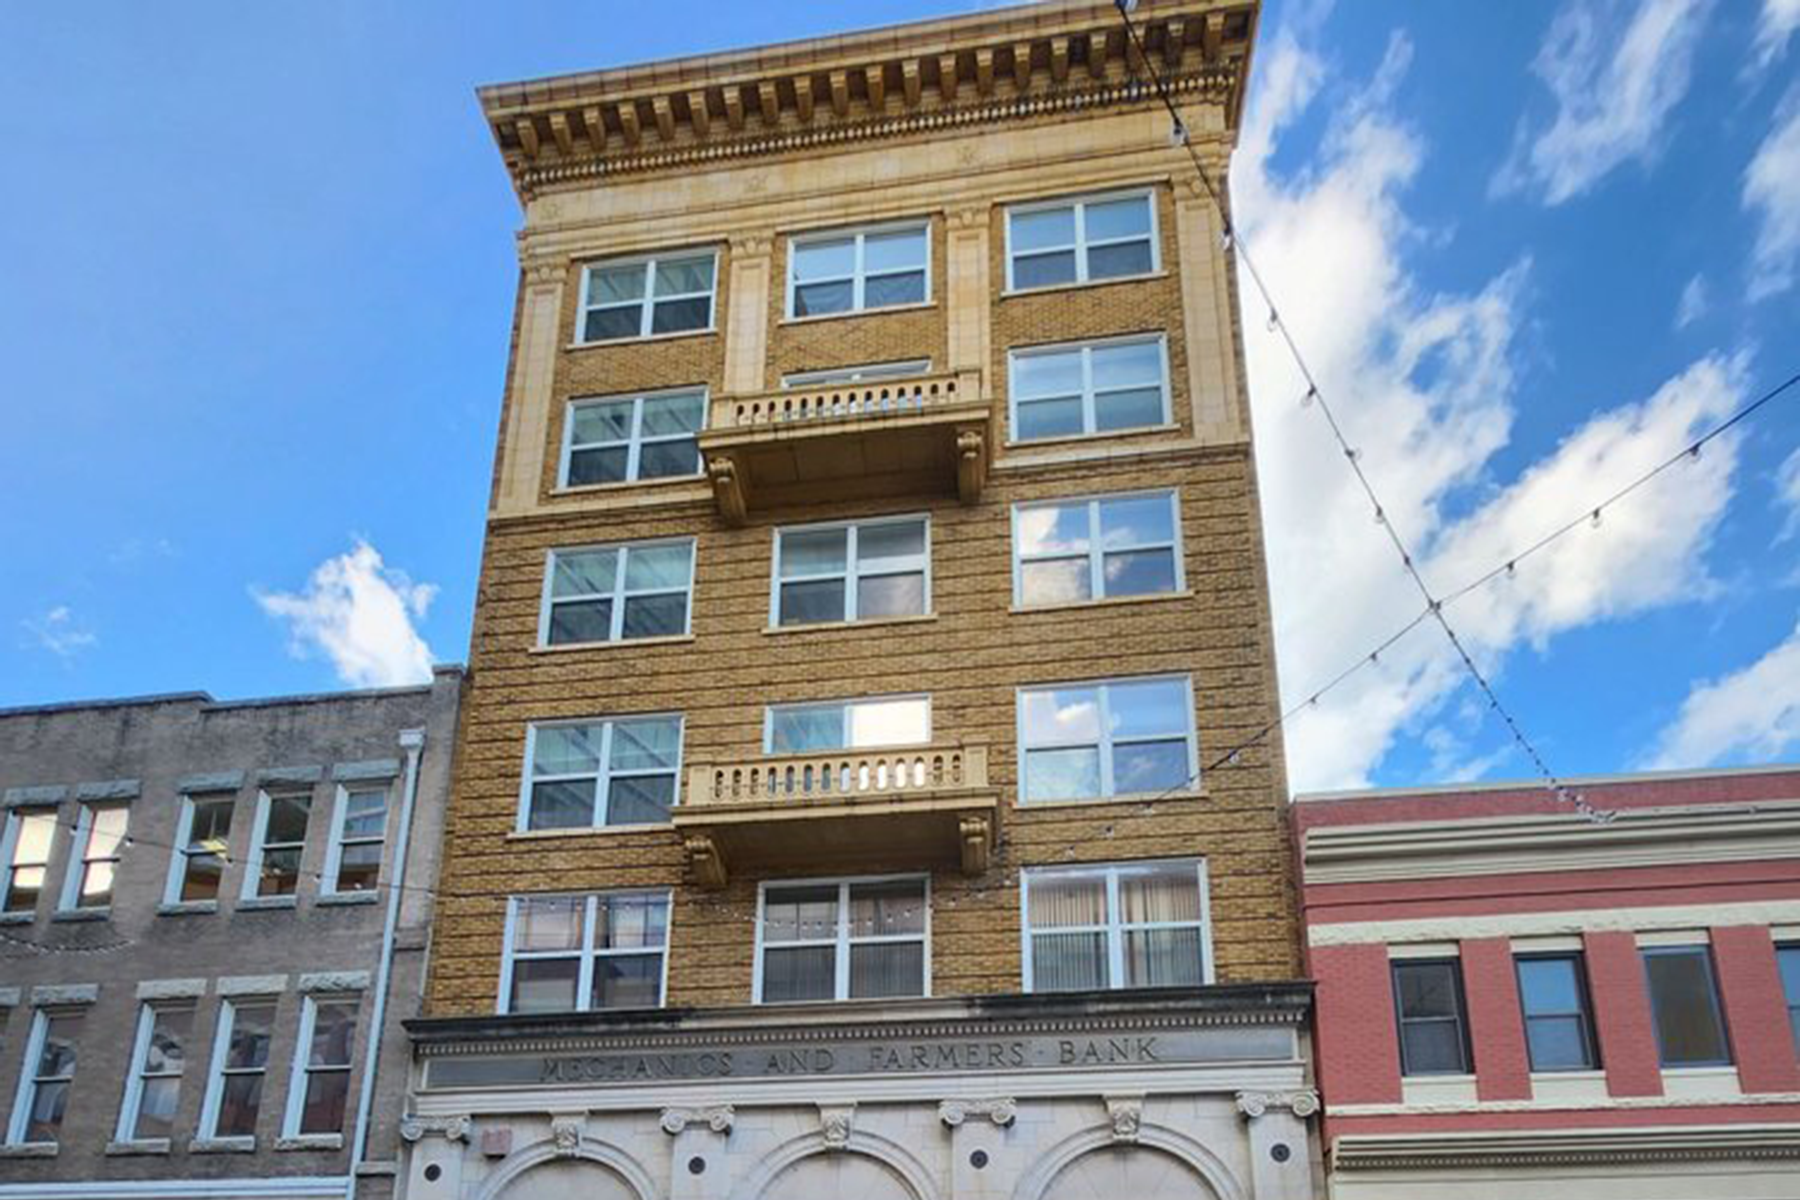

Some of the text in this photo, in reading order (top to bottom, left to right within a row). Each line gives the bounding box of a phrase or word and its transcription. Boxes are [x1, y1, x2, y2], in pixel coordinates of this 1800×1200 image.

[539, 1036, 1159, 1082] MECHANICS AND FARMERS BANK
